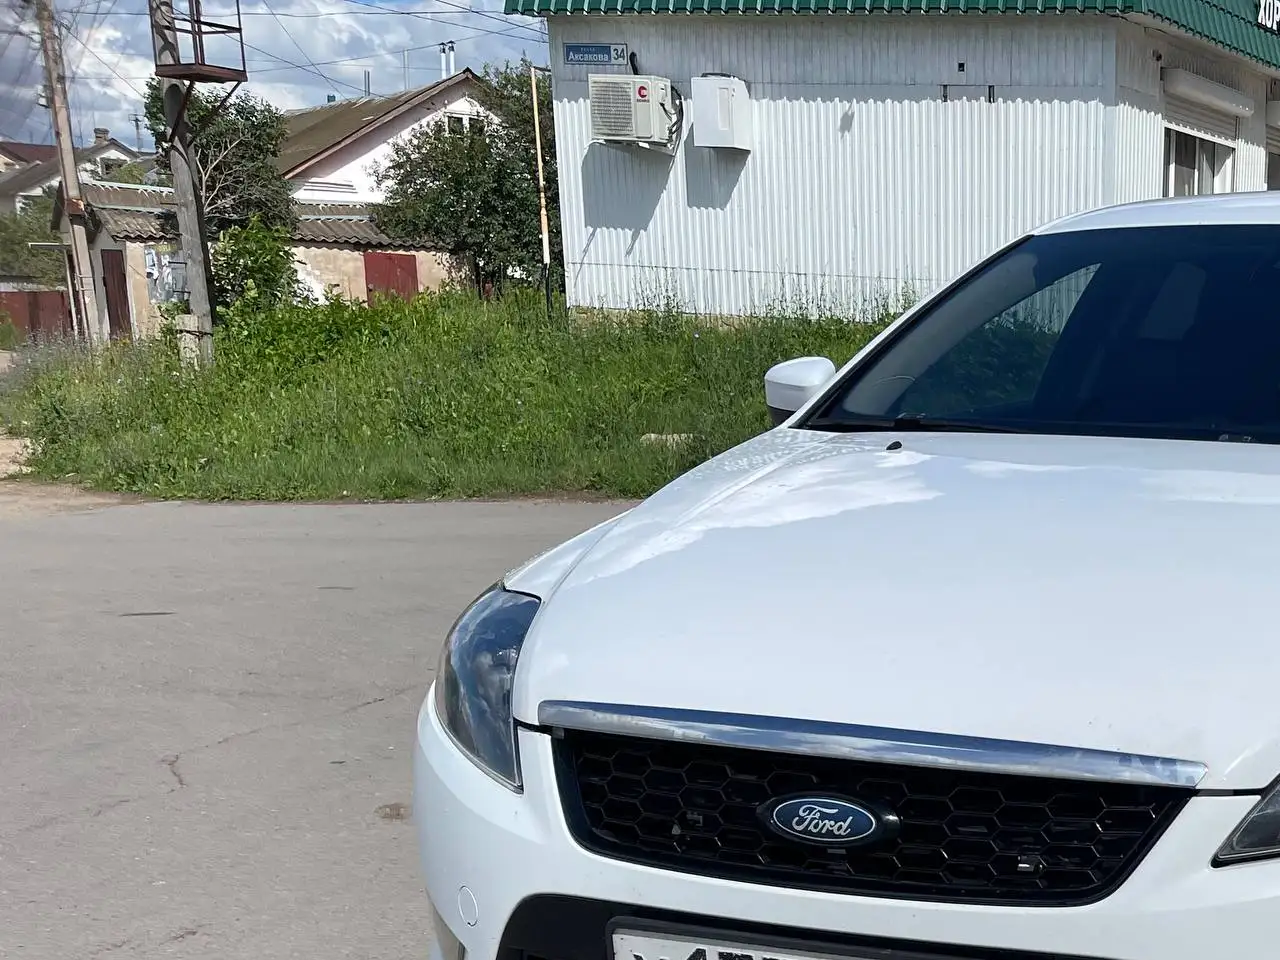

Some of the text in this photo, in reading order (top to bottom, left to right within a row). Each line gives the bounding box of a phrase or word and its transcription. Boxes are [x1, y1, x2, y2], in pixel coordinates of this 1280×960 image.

[568, 48, 626, 61] Аксакова 34
[792, 804, 853, 836] Ford
